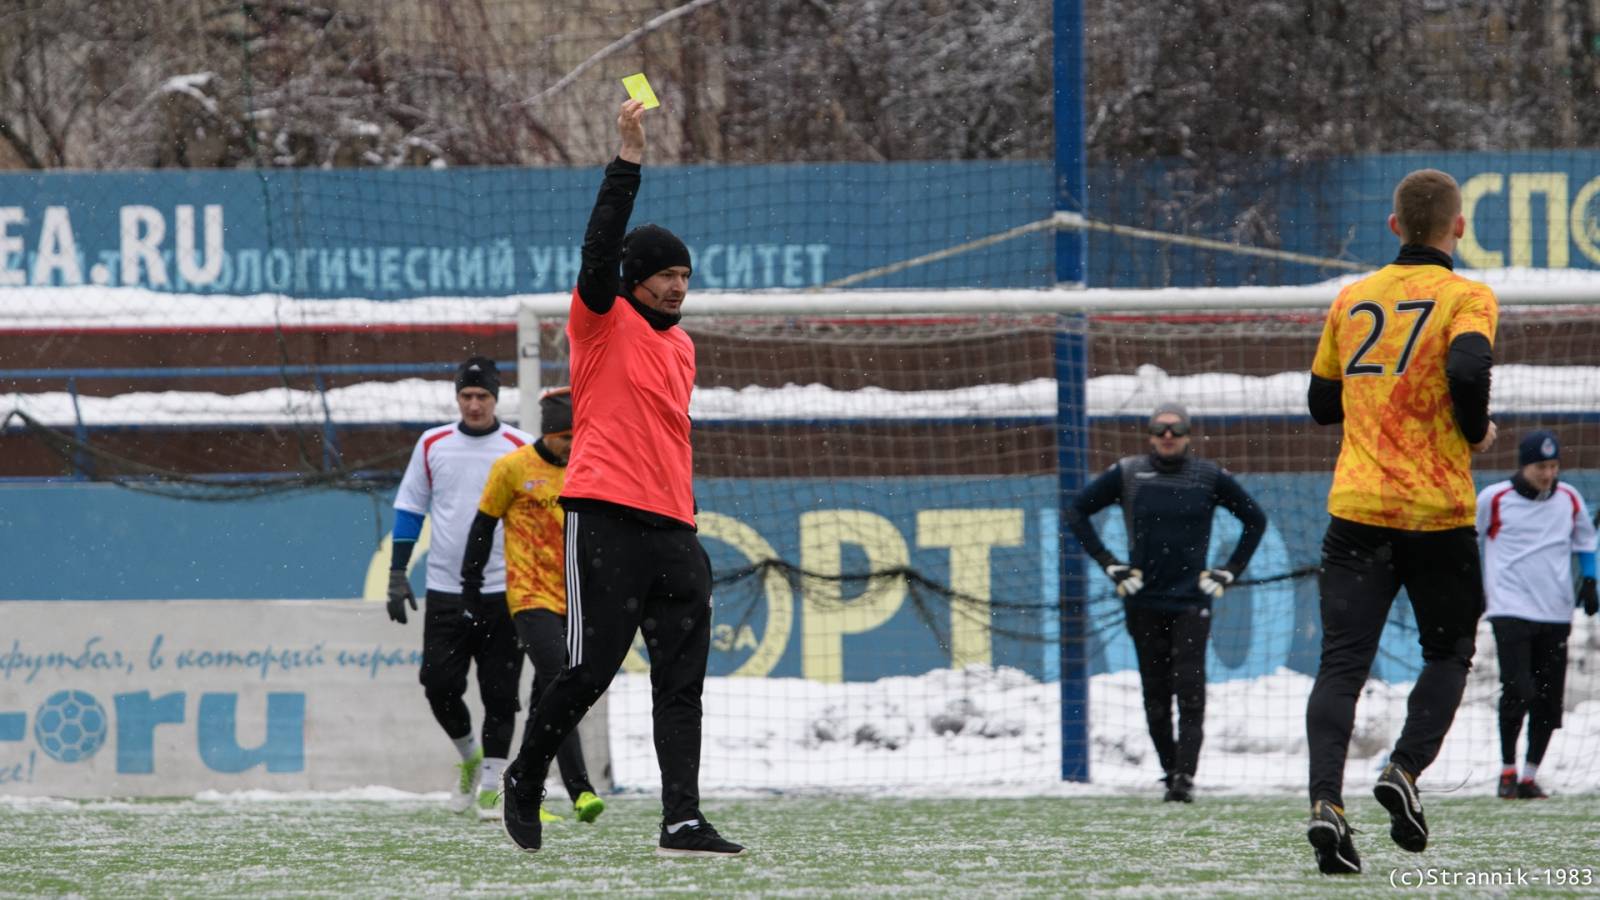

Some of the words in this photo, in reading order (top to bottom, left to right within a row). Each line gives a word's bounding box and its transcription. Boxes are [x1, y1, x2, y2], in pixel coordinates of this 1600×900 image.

[1346, 298, 1437, 377] 27
[148, 633, 165, 671] в
[175, 641, 326, 680] который
